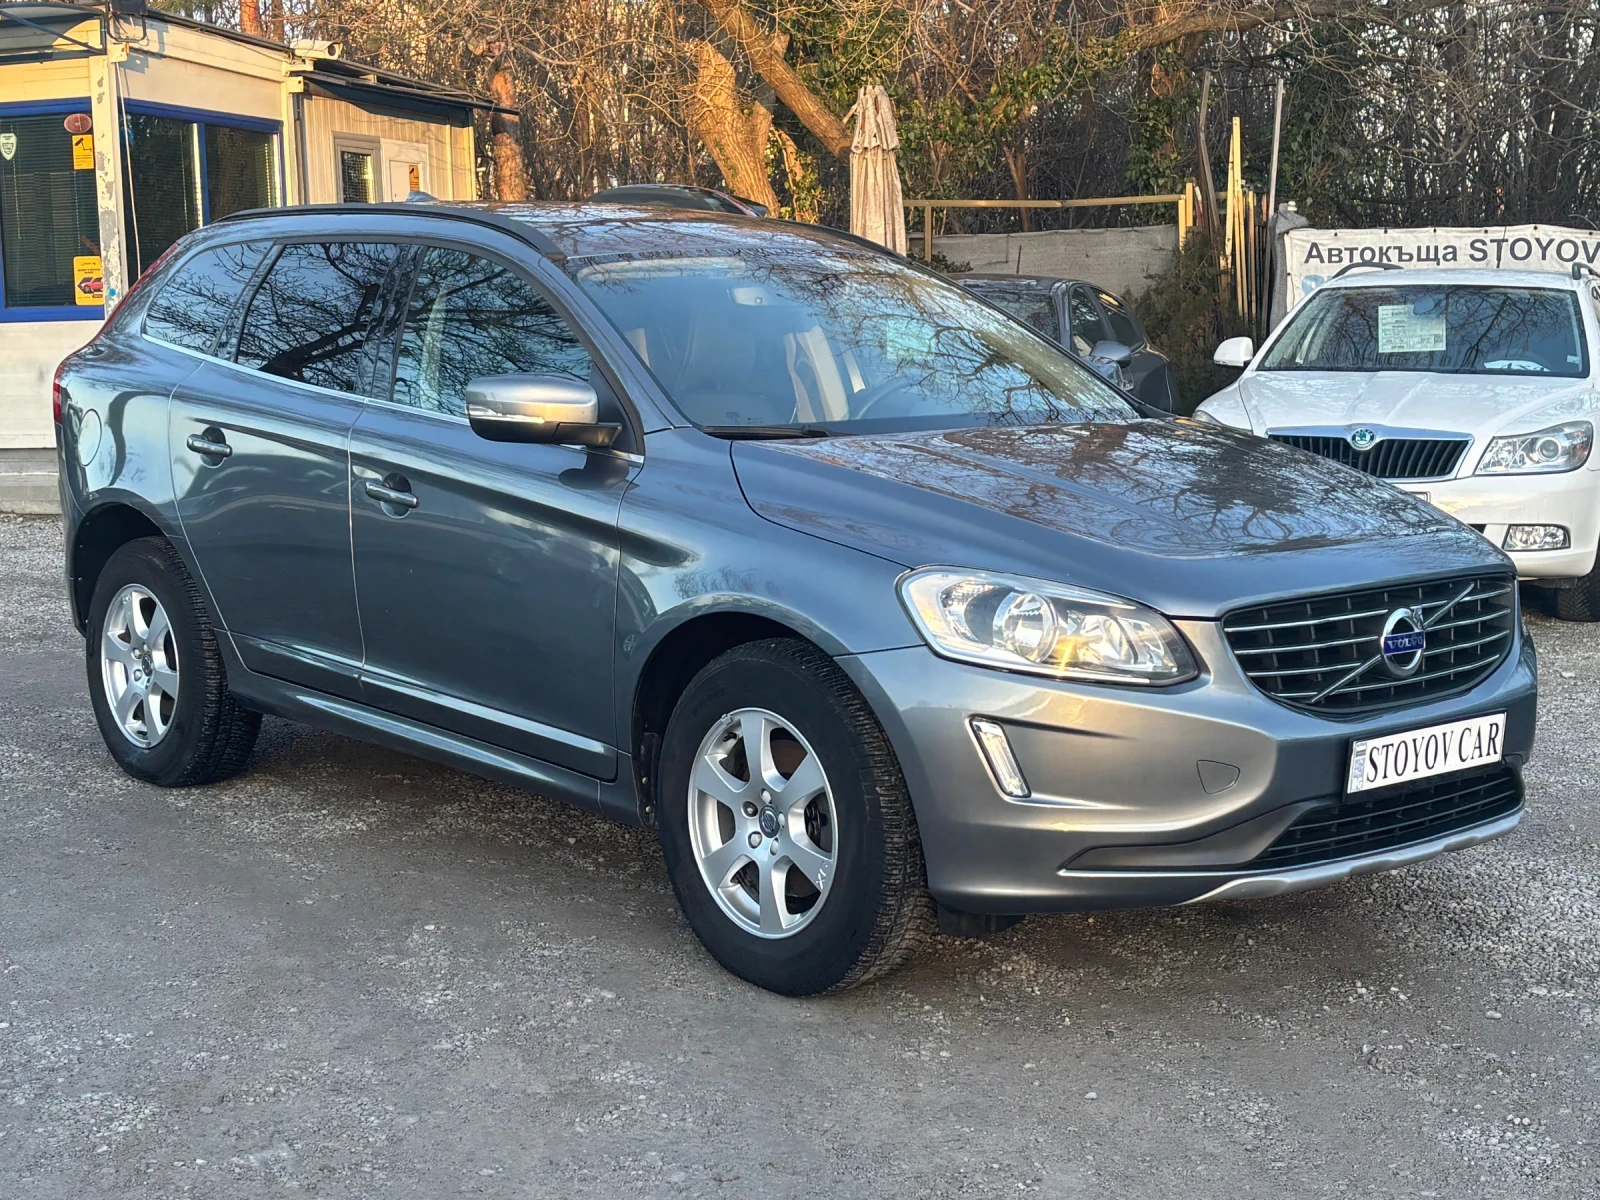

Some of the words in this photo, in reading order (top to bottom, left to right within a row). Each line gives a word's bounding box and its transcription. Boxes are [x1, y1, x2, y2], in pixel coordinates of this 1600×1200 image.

[1304, 242, 1458, 266] Автокъща
[1469, 237, 1600, 264] STOYOV
[1387, 635, 1423, 650] VOLVO
[1366, 731, 1454, 783] STOYOV
[1458, 722, 1500, 763] CAR
